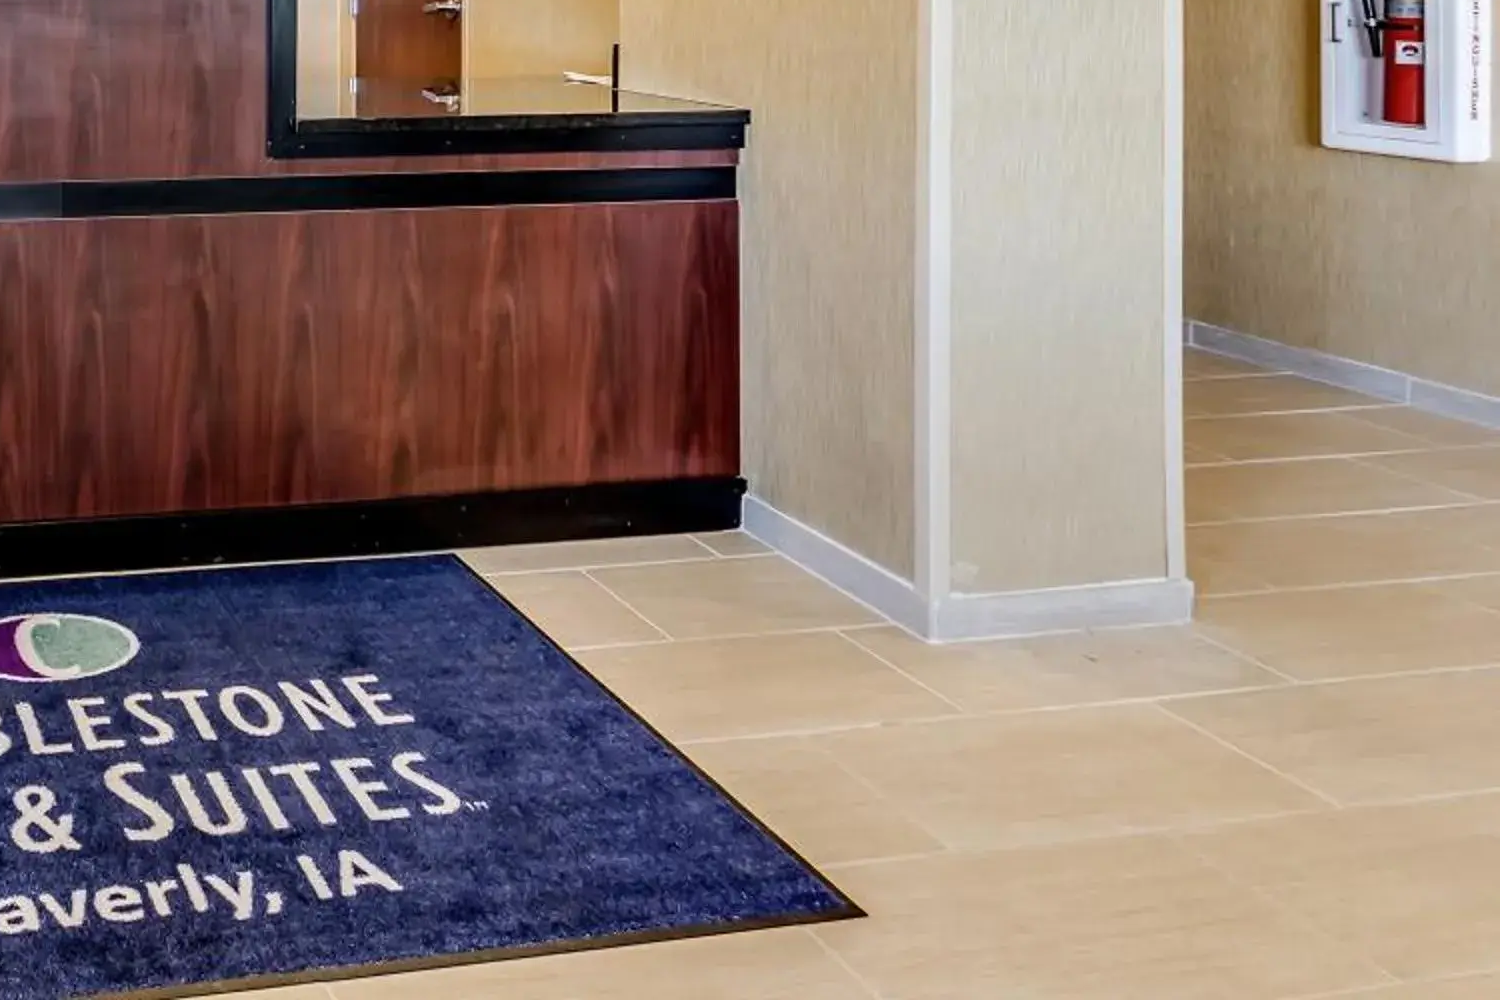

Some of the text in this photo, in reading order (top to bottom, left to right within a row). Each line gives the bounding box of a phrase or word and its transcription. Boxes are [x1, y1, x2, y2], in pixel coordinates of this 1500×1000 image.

[10, 784, 83, 854] &
[104, 751, 461, 842] SUITES
[297, 849, 404, 901] IA
